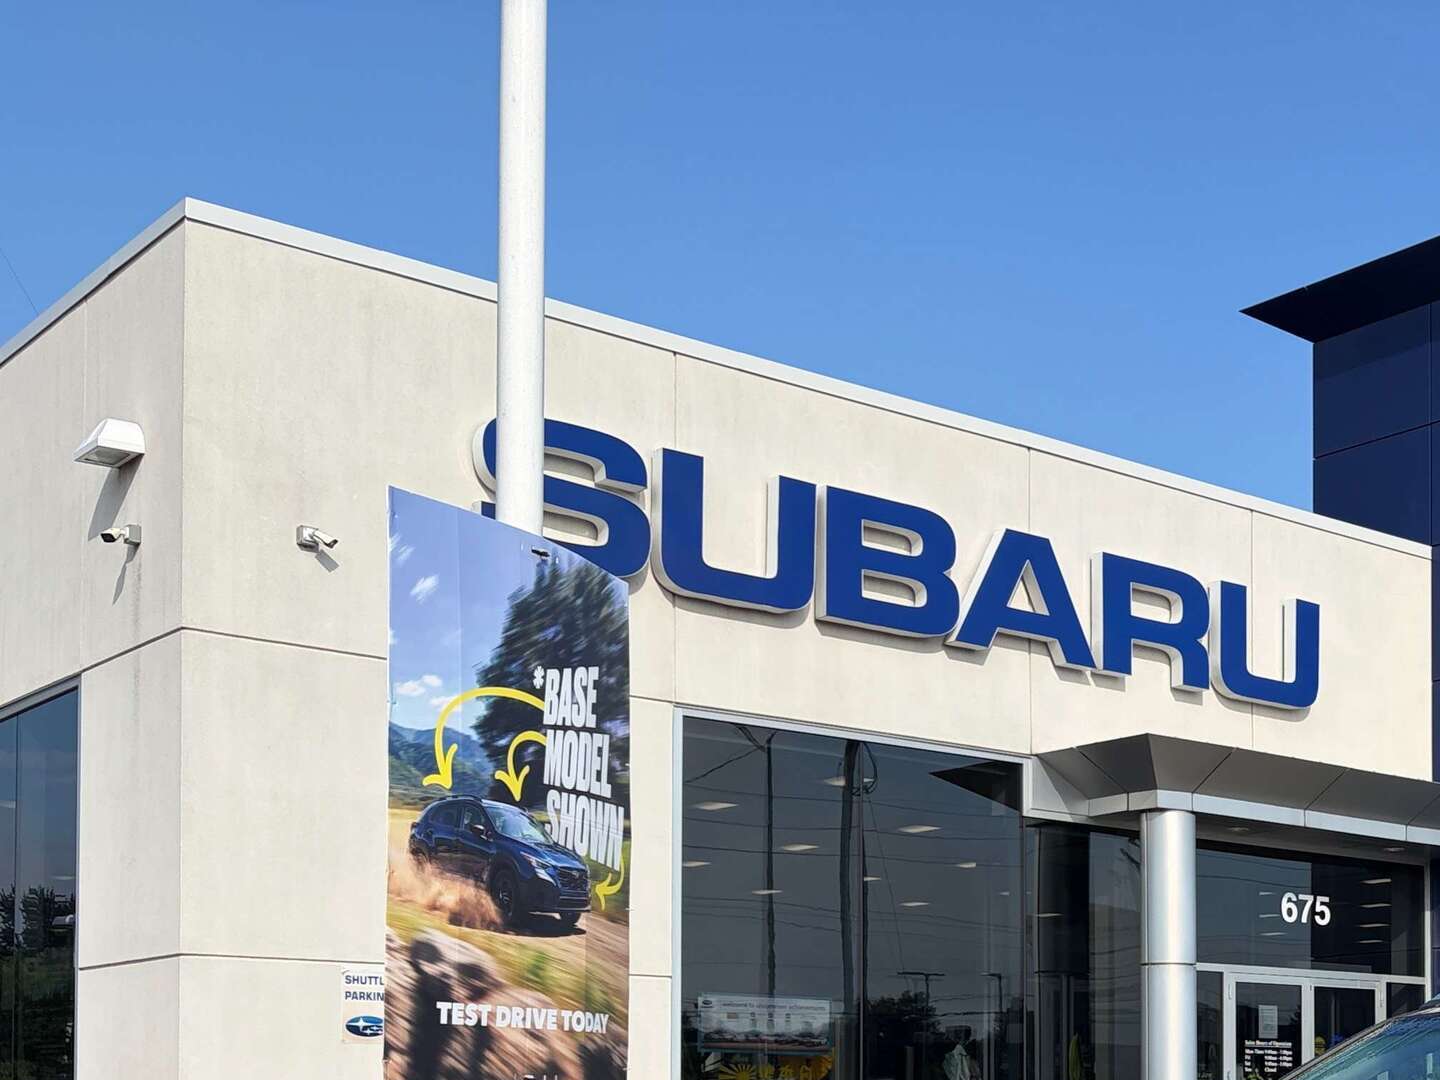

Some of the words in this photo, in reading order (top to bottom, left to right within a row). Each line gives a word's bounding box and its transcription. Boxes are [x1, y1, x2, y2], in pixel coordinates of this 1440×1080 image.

[474, 418, 1320, 709] SUBARU
[543, 728, 612, 799] MODEL
[544, 789, 624, 872] SHOWN
[1280, 892, 1332, 926] 675
[345, 975, 384, 986] SHUTTL
[345, 991, 384, 1001] PARKIN
[436, 1001, 491, 1027] TEST
[495, 1005, 558, 1030] DRIVE
[561, 1009, 609, 1034] TODAY
